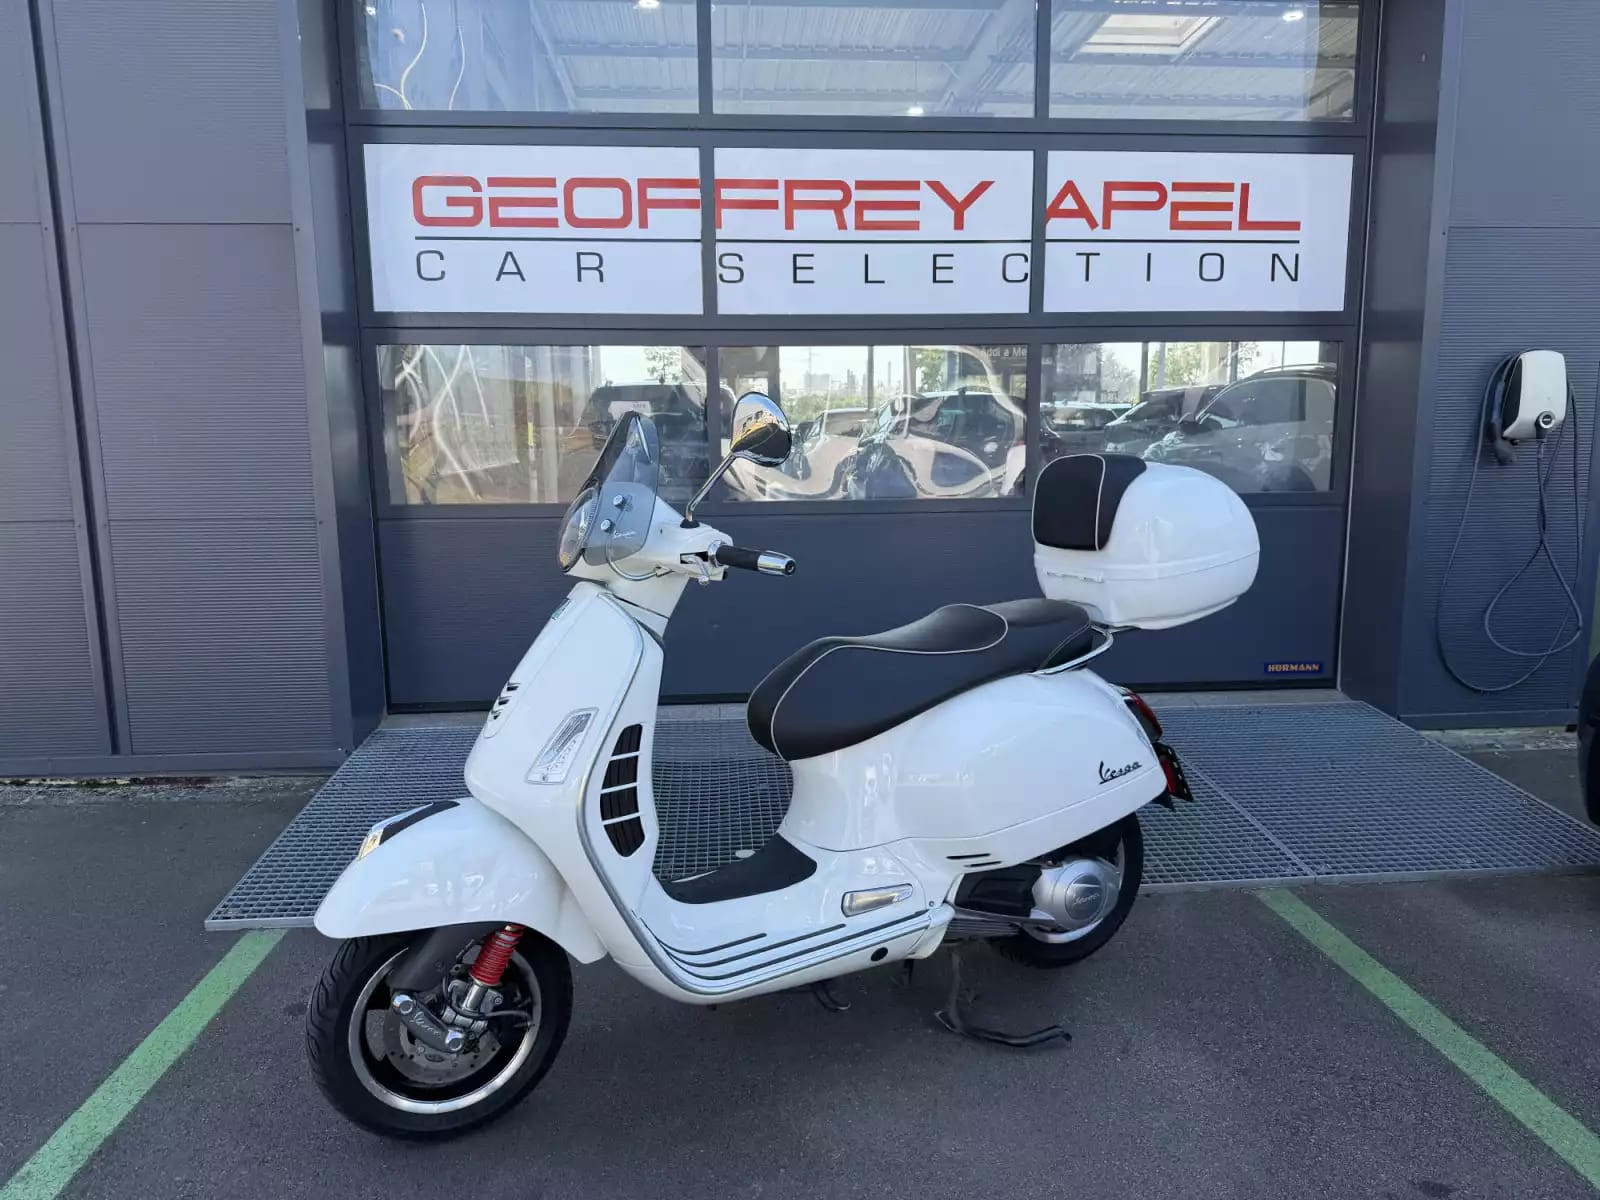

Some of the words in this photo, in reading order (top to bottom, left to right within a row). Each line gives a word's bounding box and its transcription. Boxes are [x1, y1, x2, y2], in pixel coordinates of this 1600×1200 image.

[412, 175, 995, 230] GEOFFREY
[1045, 180, 1301, 231] APEL
[416, 250, 604, 282] CAR
[718, 252, 1300, 284] SELECTION
[1099, 760, 1143, 785] Vespa
